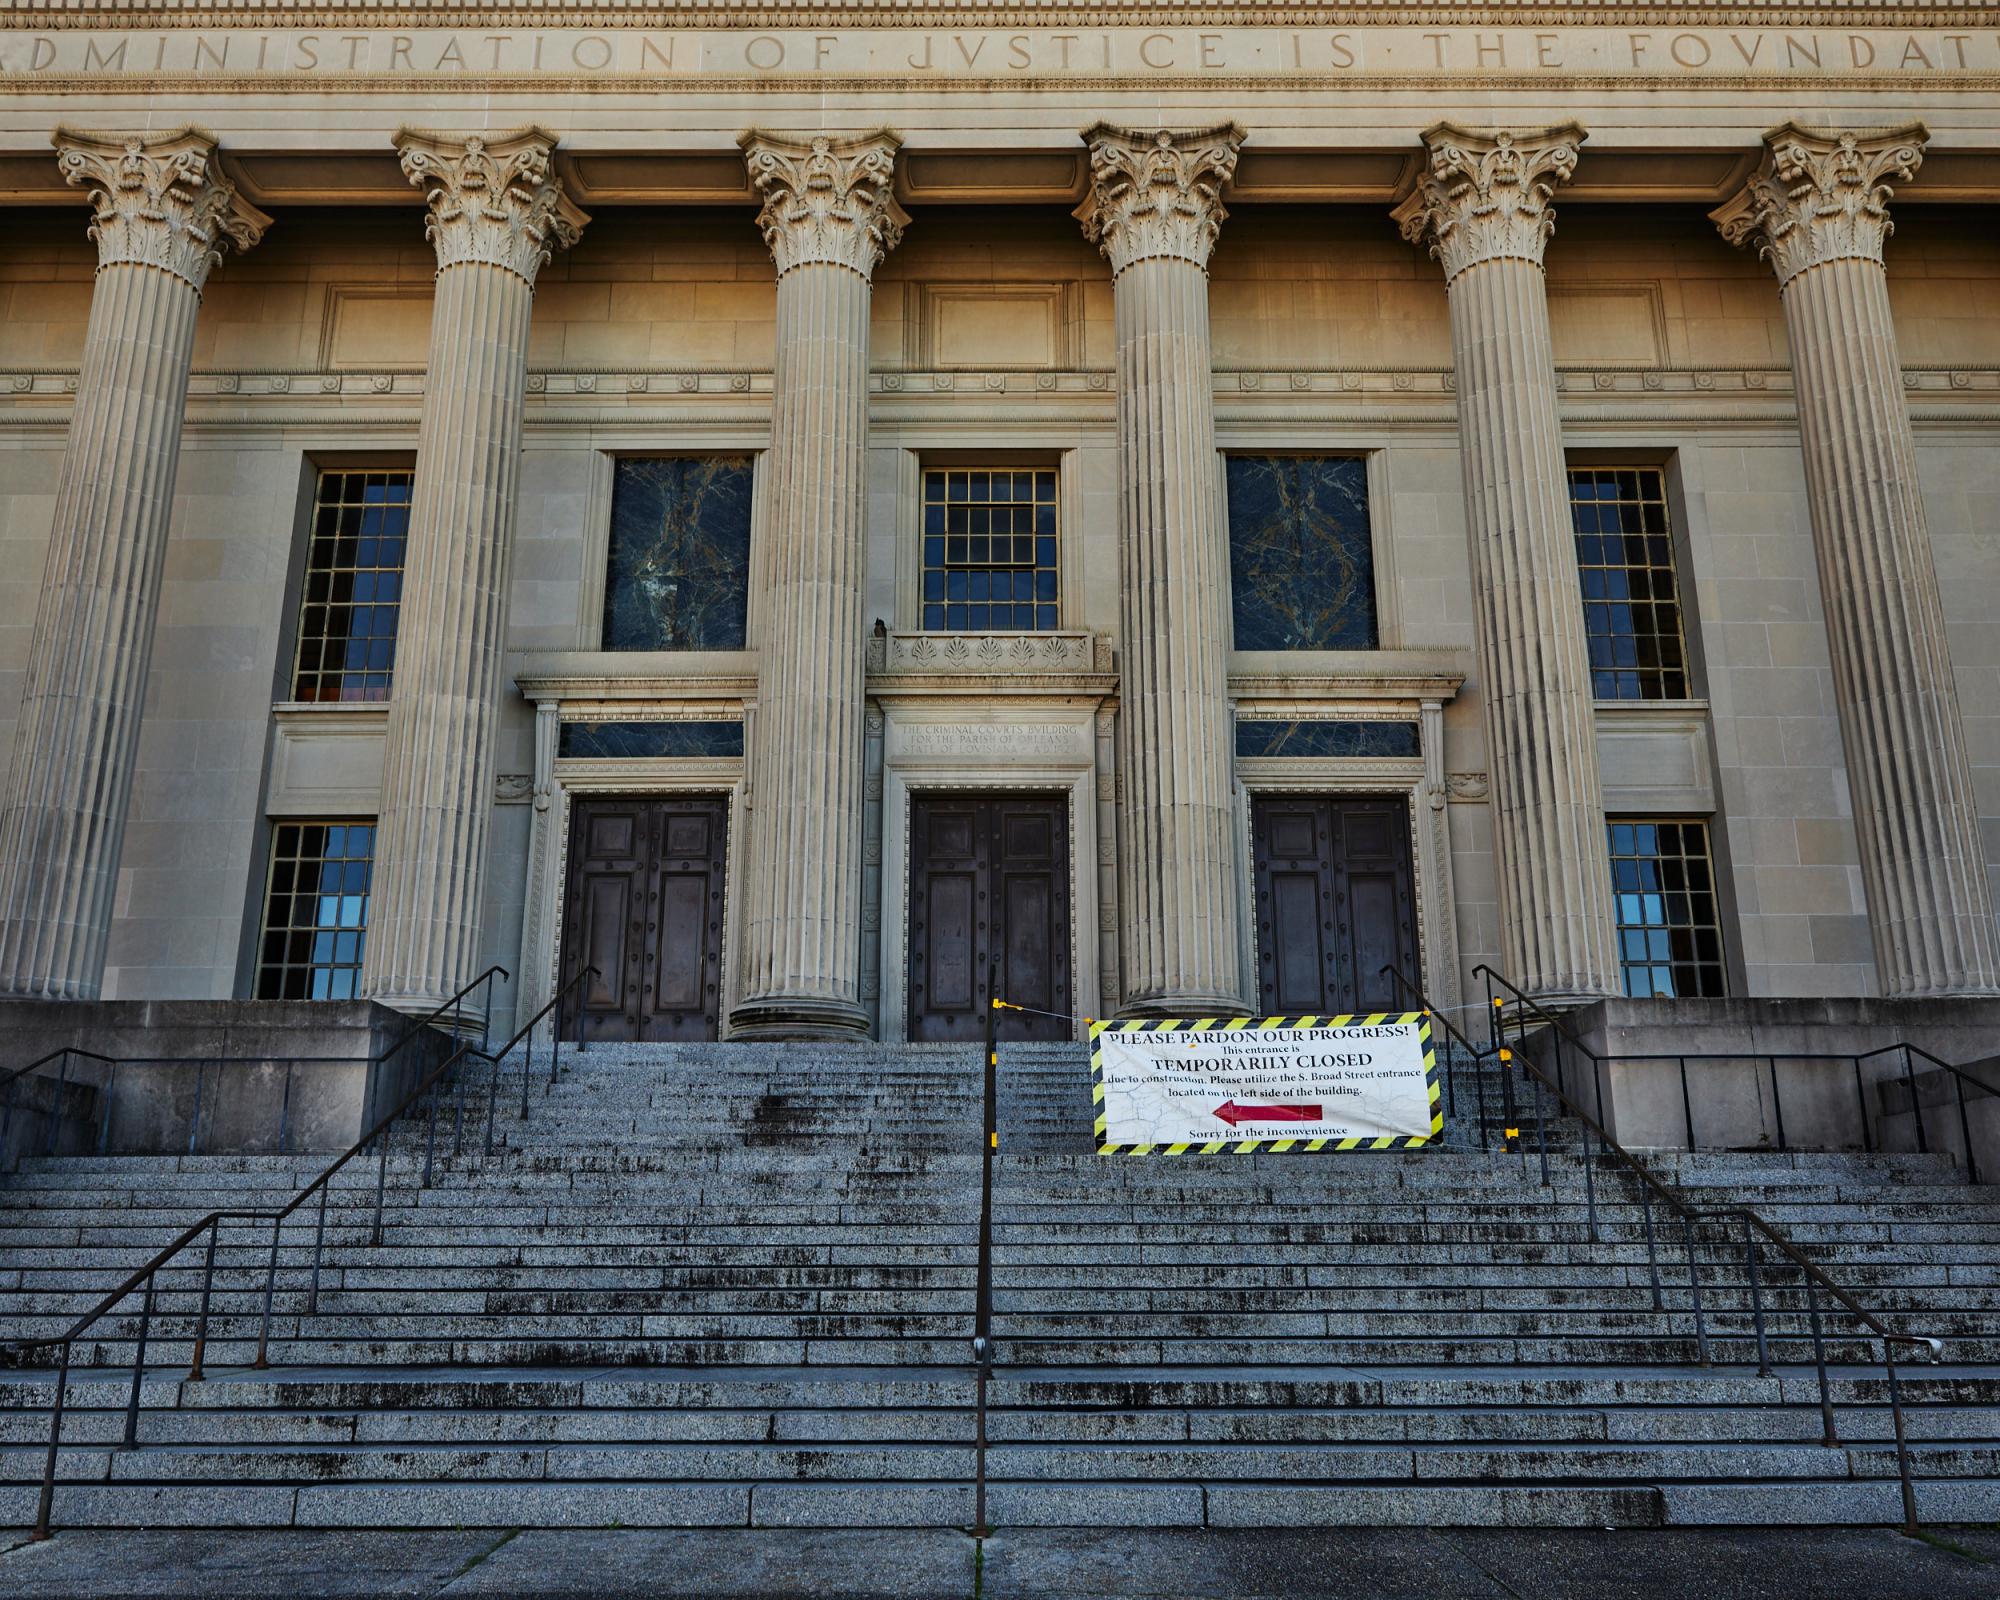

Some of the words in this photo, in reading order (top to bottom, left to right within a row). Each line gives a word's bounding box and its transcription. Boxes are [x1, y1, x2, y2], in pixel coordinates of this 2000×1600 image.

[0, 36, 678, 71] DMINISTRATION
[743, 35, 839, 70] OF
[906, 34, 1227, 70] JVSTICE
[1291, 34, 1356, 69] IS
[1422, 33, 1565, 69] THE
[903, 725, 921, 734] THE
[925, 725, 974, 734] CRIMINAL
[911, 735, 932, 744] FOR
[960, 735, 996, 744] PARISH
[1000, 735, 1012, 744] OF
[1109, 1032, 1176, 1045] PLEASE
[1181, 1031, 1258, 1044] PARDON
[1263, 1030, 1305, 1043] OUR
[1309, 1025, 1410, 1041] PROGRESS!
[1221, 1046, 1243, 1055] This
[1245, 1046, 1289, 1055] entrance
[1292, 1045, 1300, 1053] is
[1151, 1055, 1292, 1072] TEMPORARILY
[1296, 1053, 1373, 1069] CLOSED
[1107, 1074, 1127, 1084] due
[1128, 1075, 1139, 1084] to
[1141, 1075, 1207, 1085] construction.
[1210, 1075, 1242, 1085] Please
[1244, 1074, 1277, 1084] utilize
[1280, 1073, 1297, 1083] the
[1298, 1073, 1309, 1082] S.
[1311, 1071, 1343, 1081] Broad
[1344, 1070, 1375, 1080] Street
[1377, 1068, 1422, 1078] entrance
[1168, 1088, 1205, 1098] located
[1207, 1090, 1220, 1098] on
[1222, 1088, 1238, 1099] the
[1240, 1088, 1257, 1098] left
[1259, 1087, 1281, 1098] side
[1283, 1087, 1295, 1097] of
[1296, 1086, 1315, 1097] the
[1315, 1085, 1363, 1097] building.
[1189, 1129, 1222, 1140] Sorry
[1225, 1128, 1242, 1138] for
[1245, 1127, 1265, 1137] the
[1267, 1126, 1349, 1137] inconvenience
